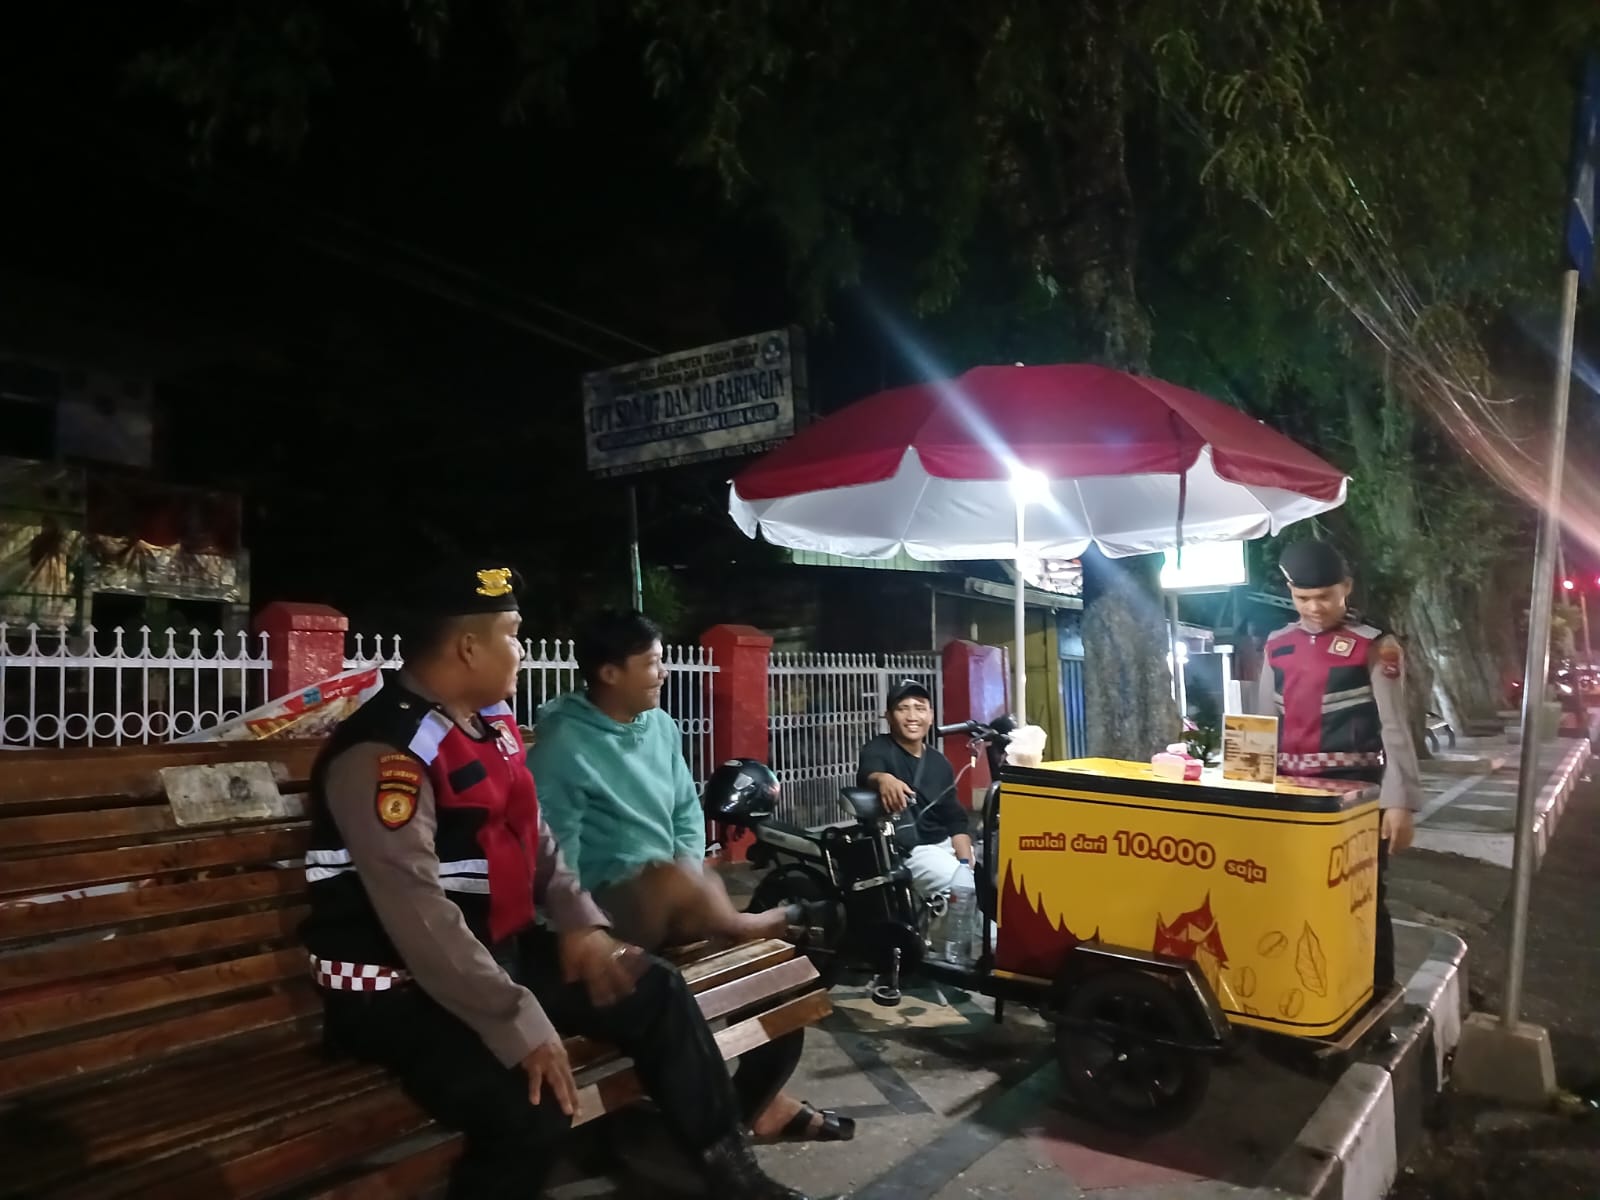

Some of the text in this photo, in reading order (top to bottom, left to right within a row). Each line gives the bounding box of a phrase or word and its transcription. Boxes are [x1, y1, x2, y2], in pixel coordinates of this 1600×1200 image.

[664, 388, 690, 417] DAN
[696, 382, 711, 411] 10
[715, 369, 783, 406] BARINGIN
[1020, 831, 1266, 883] mulai dari 10.000 saja
